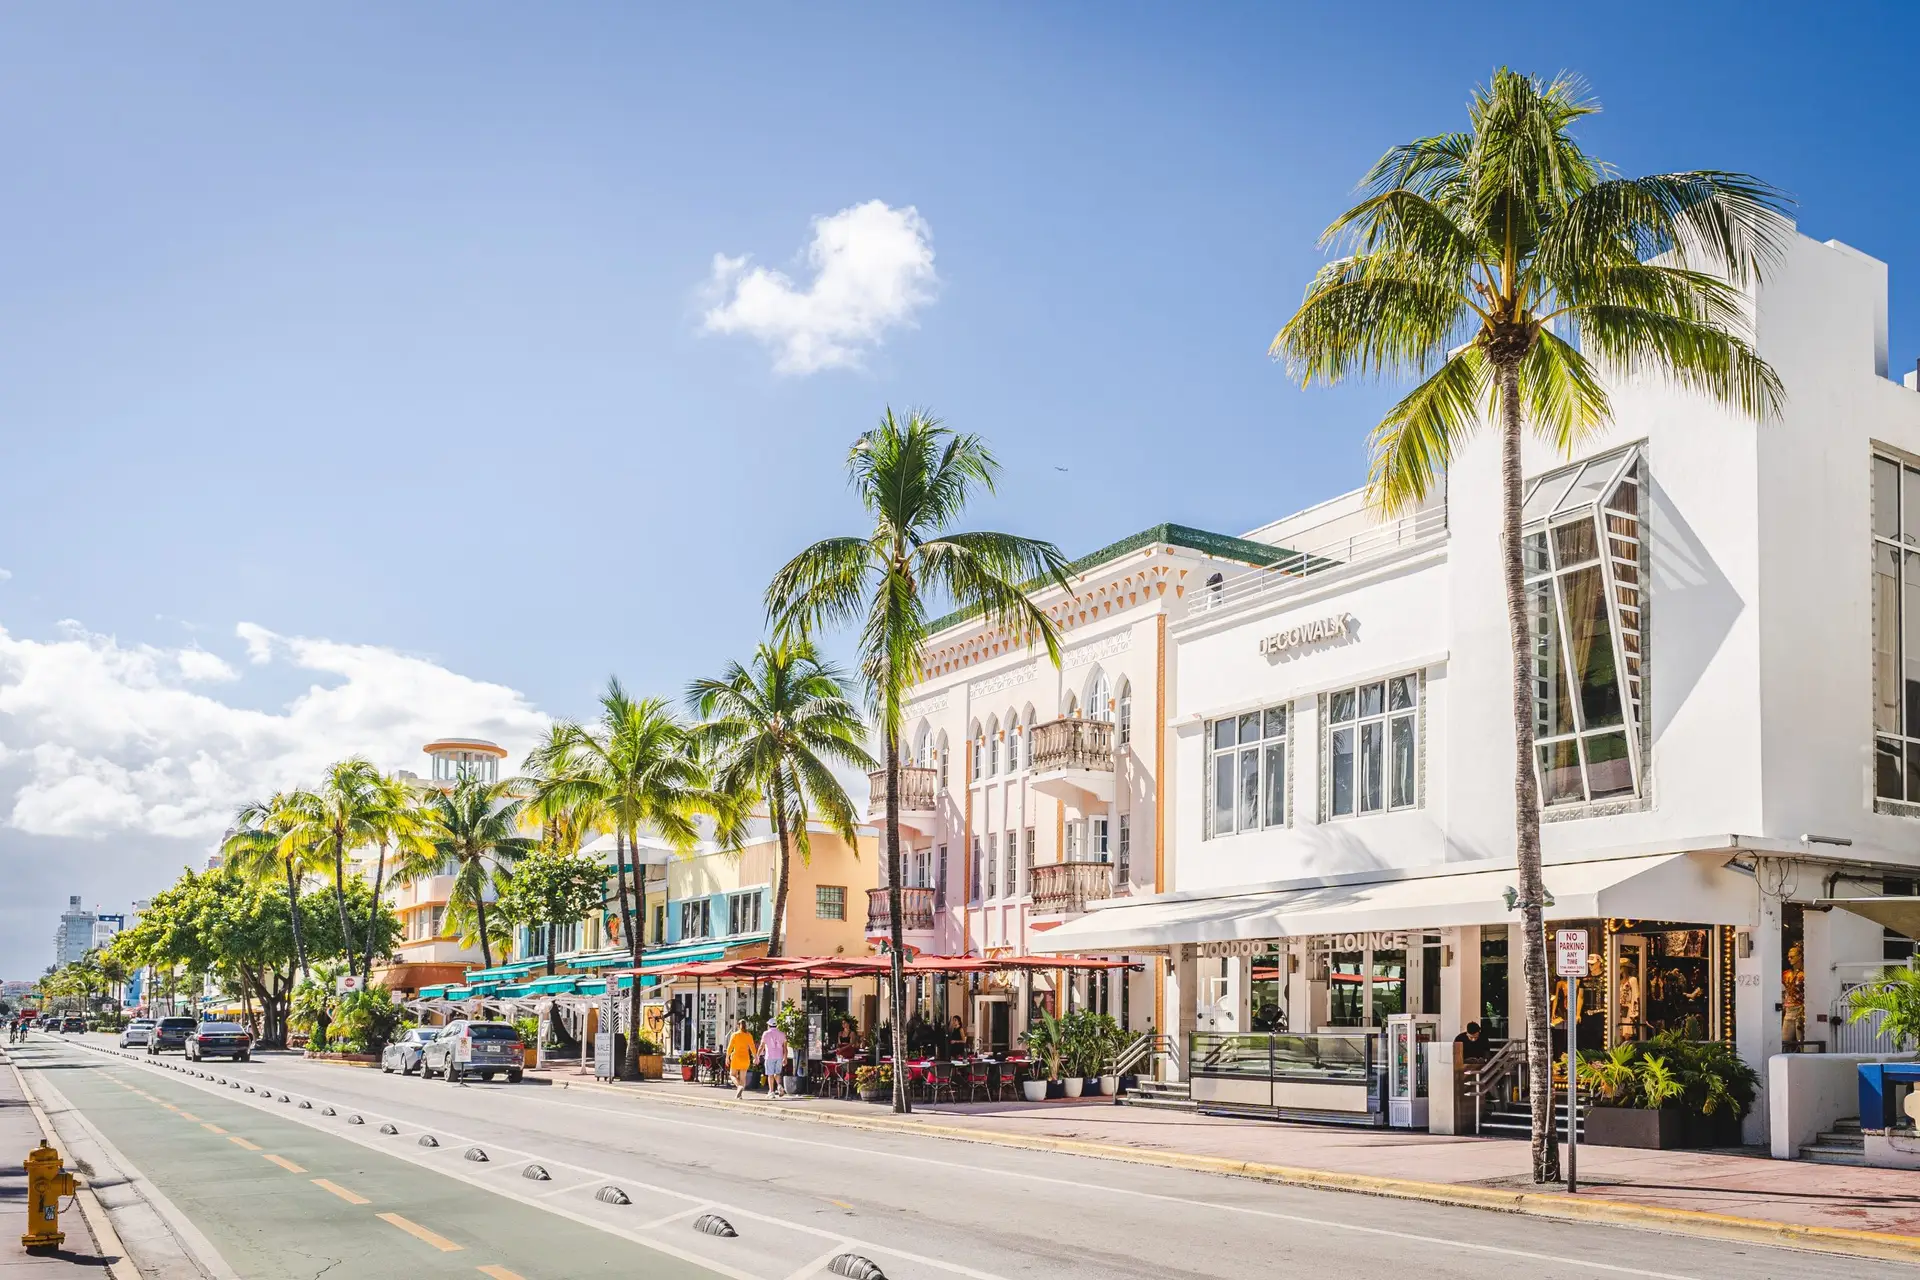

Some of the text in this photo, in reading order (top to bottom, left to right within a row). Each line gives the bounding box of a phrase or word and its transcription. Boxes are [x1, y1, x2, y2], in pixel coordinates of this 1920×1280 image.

[1259, 613, 1351, 656] DECOWALK
[1335, 931, 1408, 953] LOUNGE
[1566, 933, 1578, 941] NO
[1200, 939, 1263, 958] VOODOO
[1559, 942, 1585, 951] PARKING
[1738, 974, 1760, 987] 928
[596, 1043, 611, 1052] VALE
